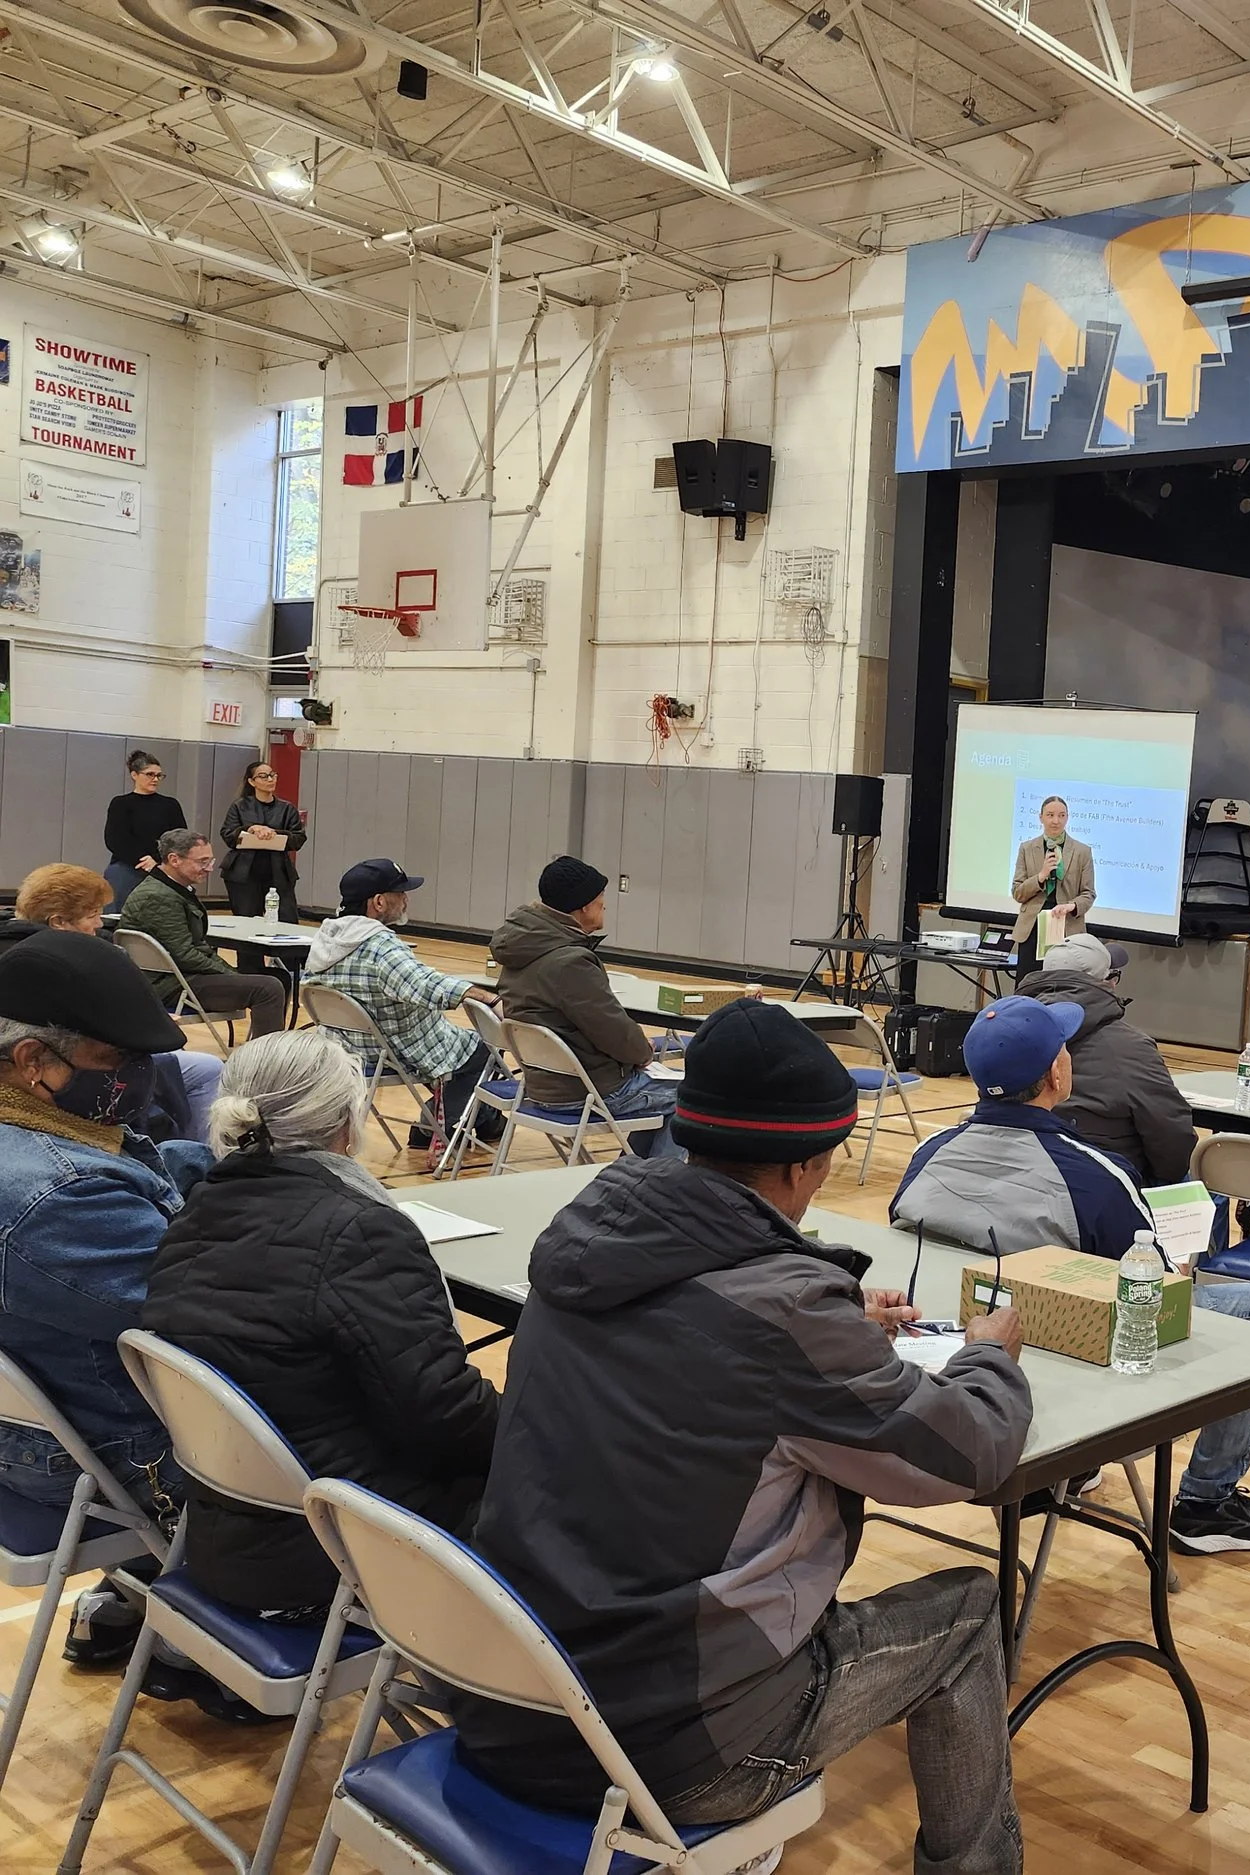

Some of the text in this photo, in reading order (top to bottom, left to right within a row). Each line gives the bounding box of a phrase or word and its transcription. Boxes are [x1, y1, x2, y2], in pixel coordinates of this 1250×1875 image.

[35, 337, 137, 376] SHOWTIME
[35, 378, 132, 414] BASKETBALL
[54, 398, 104, 414] CO-SPONSORED
[31, 425, 137, 461] TOURNAMENT
[213, 703, 240, 724] EXIT
[971, 751, 1012, 768] Agenda
[1088, 812, 1100, 820] FAB
[1115, 815, 1138, 824] Avenue
[1128, 1282, 1152, 1293] Poland
[1128, 1289, 1152, 1301] Spring
